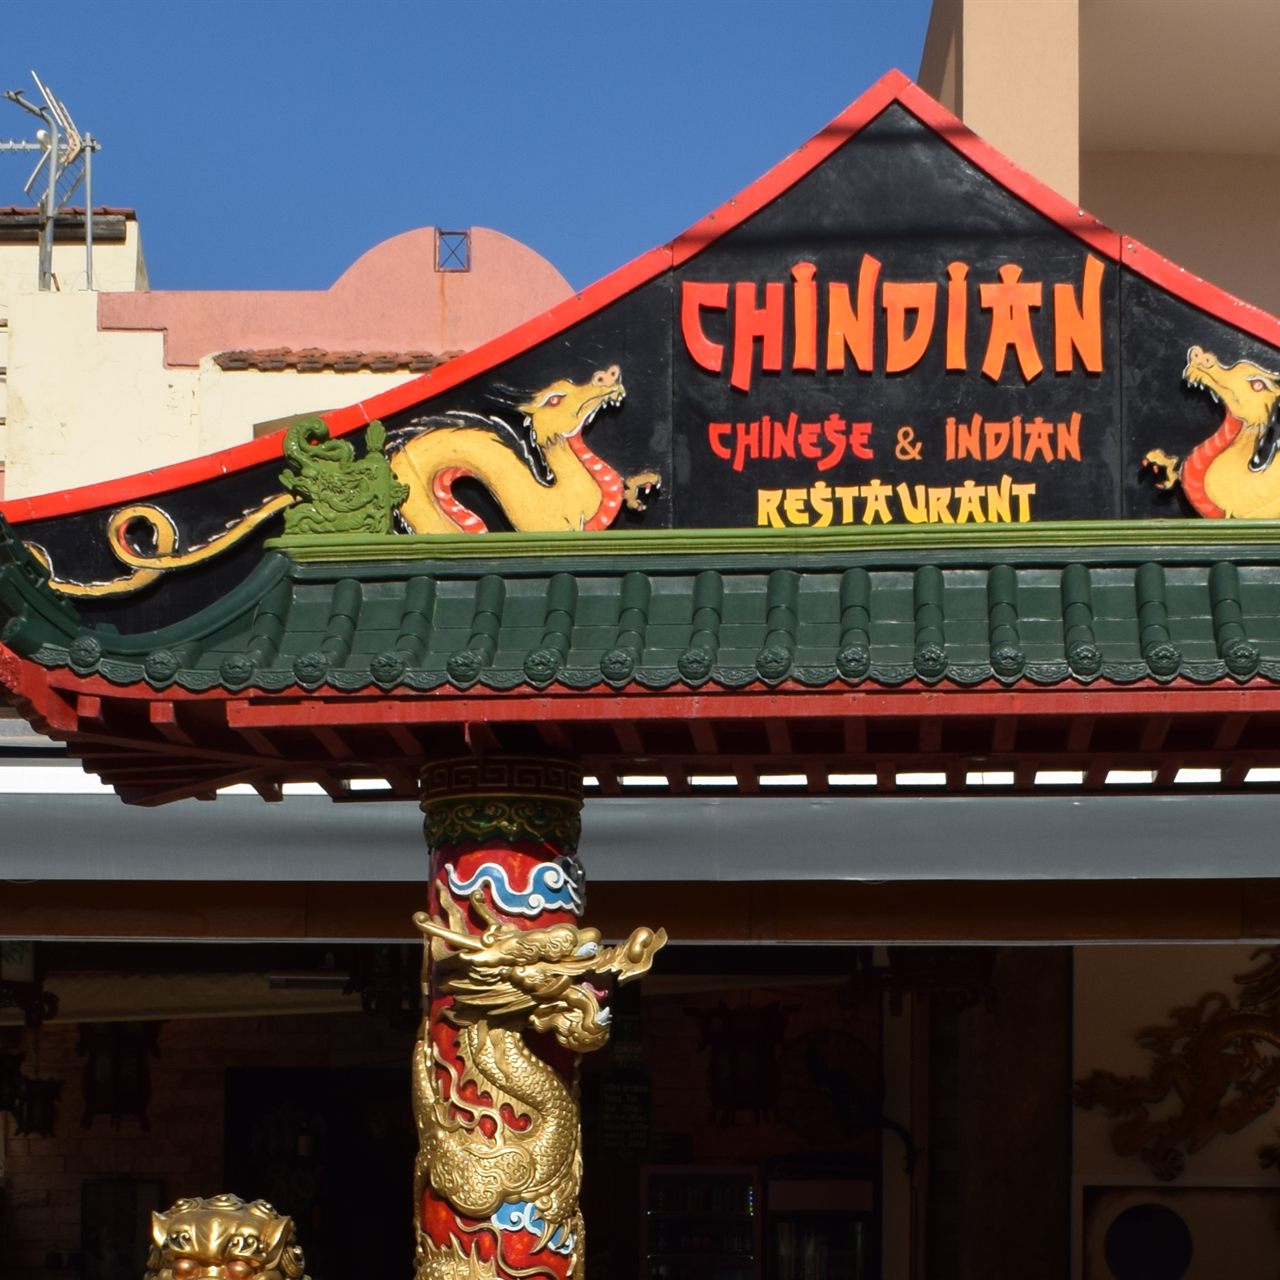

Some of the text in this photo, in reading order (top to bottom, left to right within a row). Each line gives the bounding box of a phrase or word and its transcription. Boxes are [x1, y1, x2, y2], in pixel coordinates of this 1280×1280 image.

[680, 253, 1105, 393] CHINDIAN
[708, 412, 1082, 472] CHINESE & INDIAN
[758, 475, 1036, 528] RESTAURANT
